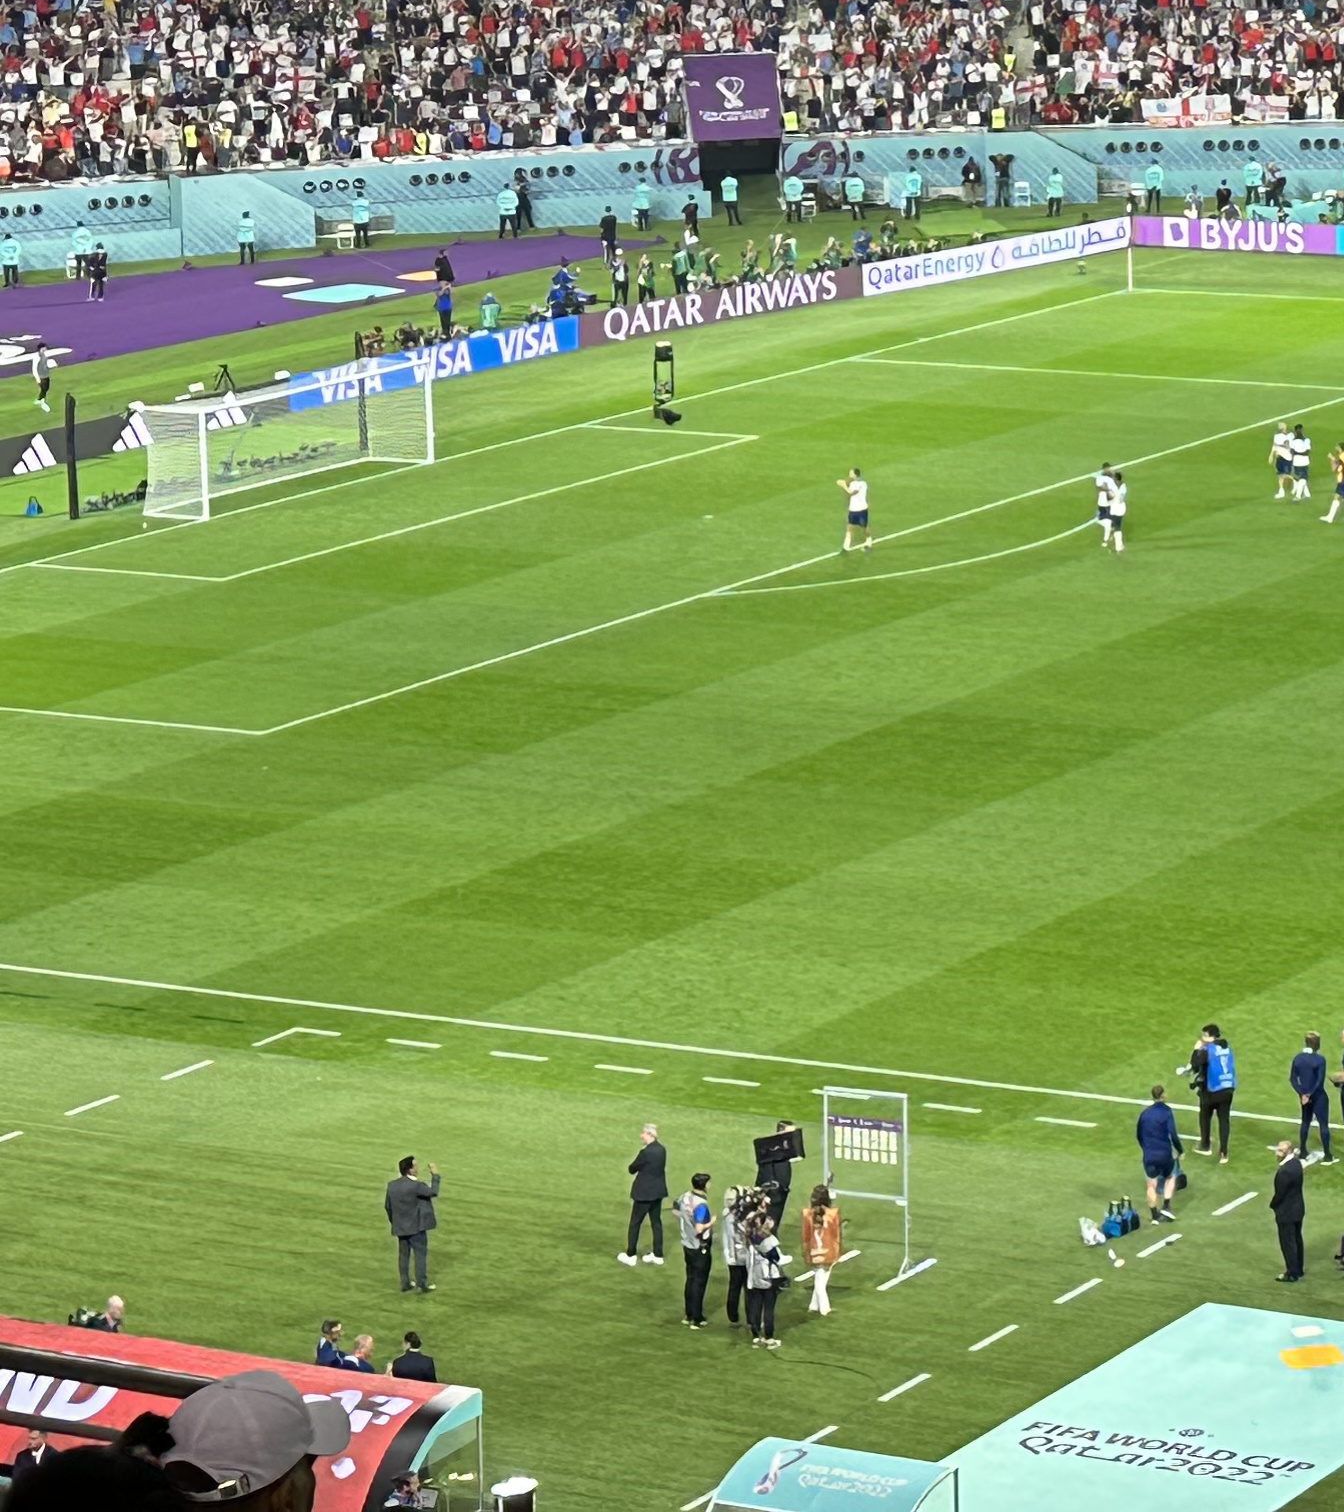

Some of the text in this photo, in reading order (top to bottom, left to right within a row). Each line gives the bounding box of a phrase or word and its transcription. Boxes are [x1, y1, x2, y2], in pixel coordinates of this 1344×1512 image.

[1200, 218, 1305, 254] BYJU'S
[867, 250, 986, 288] QatarEnergy
[603, 270, 838, 341] QATAR AIRWAYS
[406, 340, 472, 384] VISA
[492, 321, 559, 363] VISA
[313, 360, 383, 403] VISA
[1021, 1420, 1316, 1473] FIFA WORLD CUP
